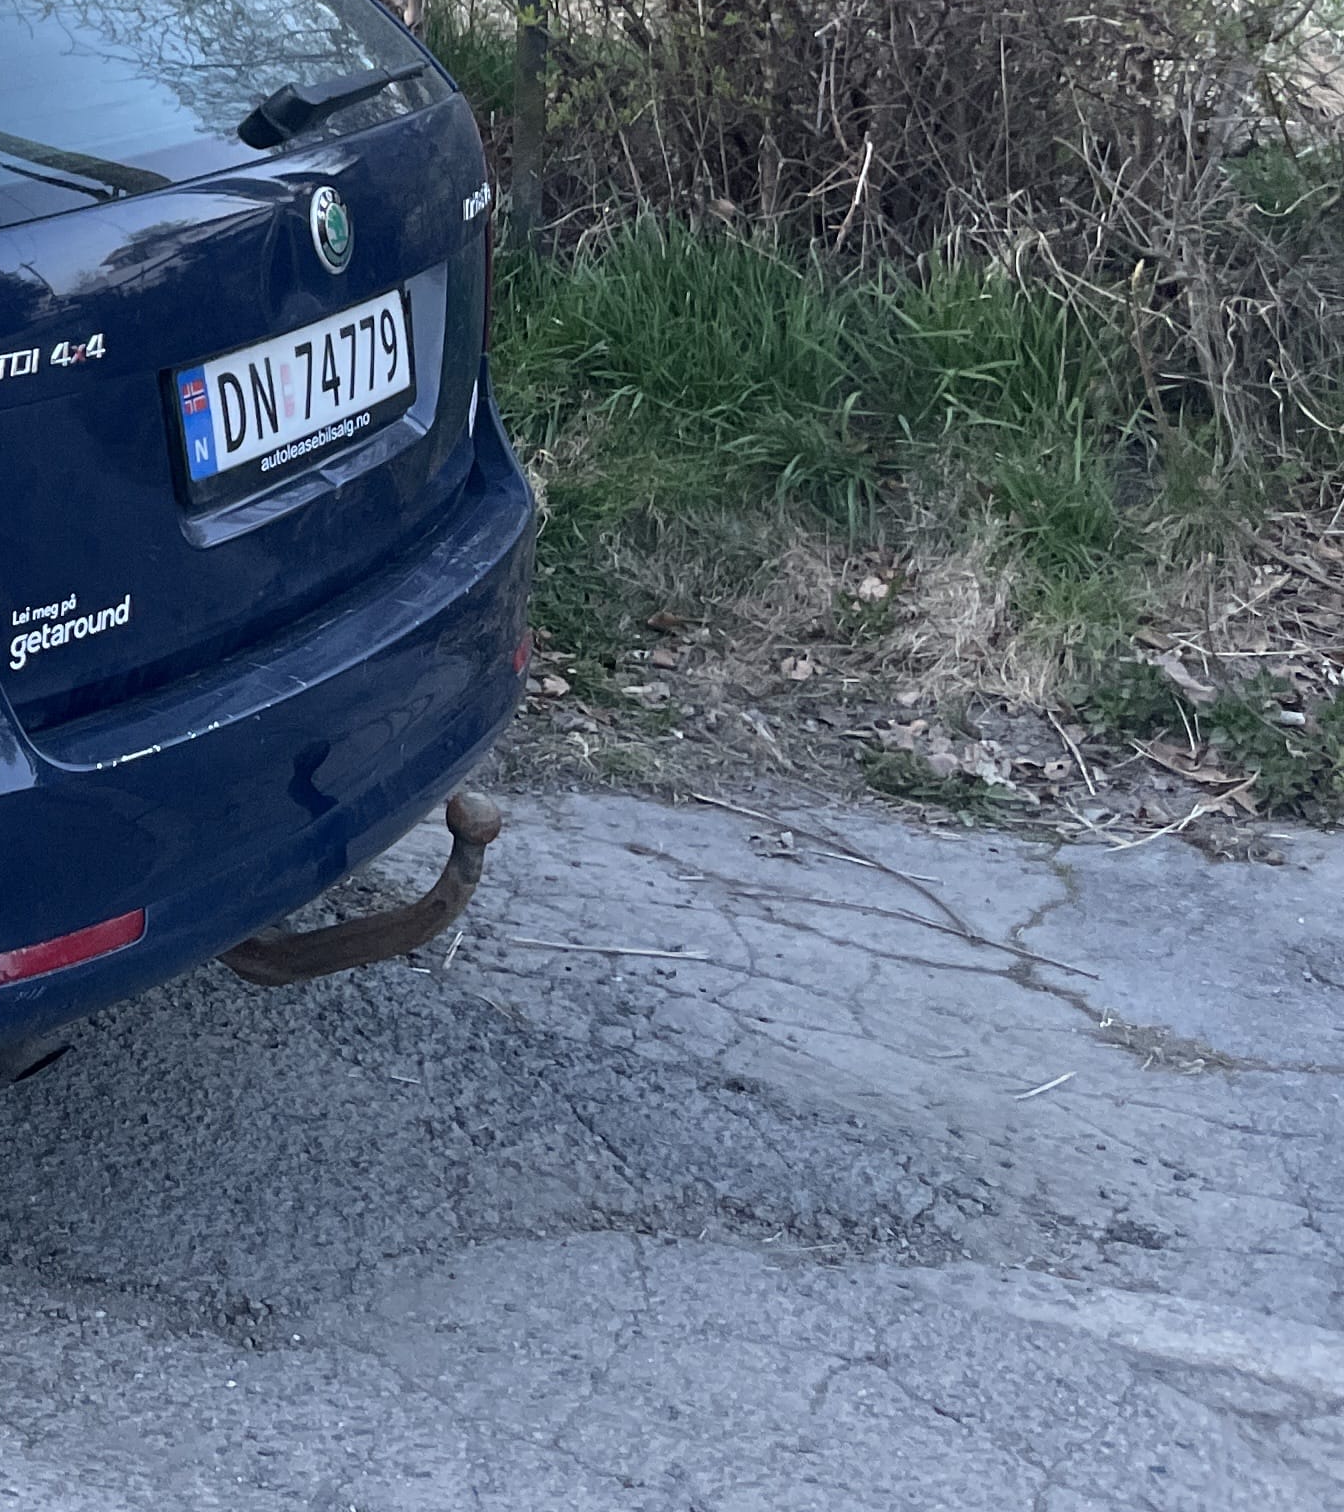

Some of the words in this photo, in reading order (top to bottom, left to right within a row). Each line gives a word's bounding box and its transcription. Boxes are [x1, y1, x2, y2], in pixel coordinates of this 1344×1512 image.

[50, 333, 106, 367] 4x4
[217, 356, 279, 454] DN
[294, 308, 398, 420] 74779
[194, 437, 209, 463] N
[260, 411, 370, 472] autoleasebilsalg.no
[9, 594, 130, 670] getaround
[12, 607, 30, 626] Lei
[32, 603, 59, 619] meg
[60, 593, 77, 617] på
